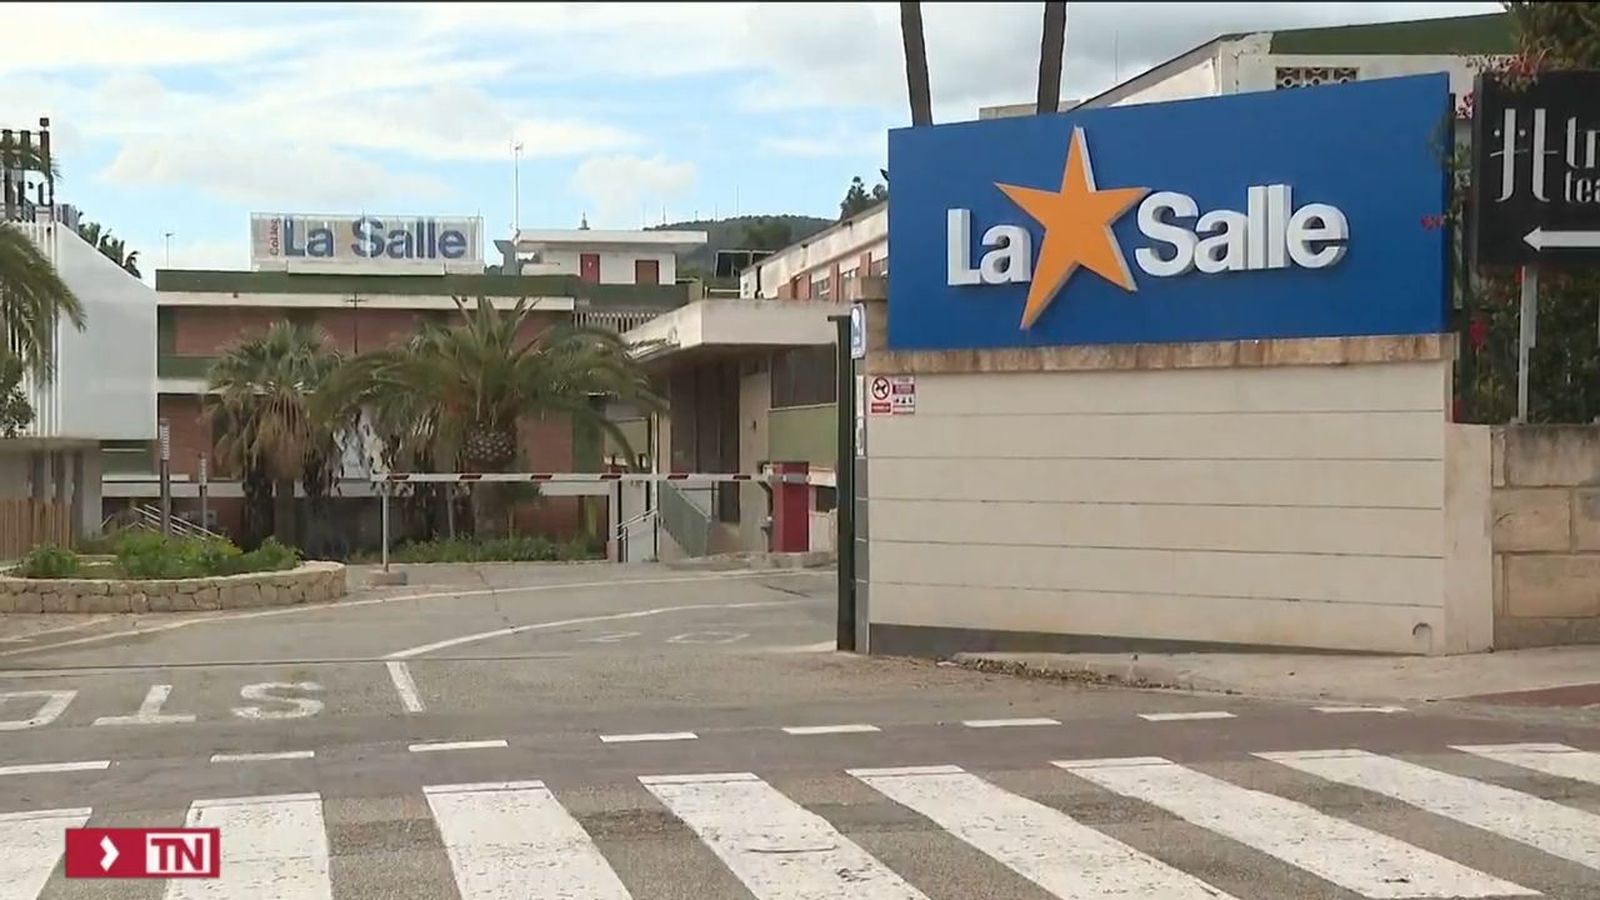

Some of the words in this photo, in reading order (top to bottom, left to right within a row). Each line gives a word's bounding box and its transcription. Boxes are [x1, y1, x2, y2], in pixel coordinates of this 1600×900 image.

[283, 215, 334, 258] La
[351, 216, 467, 259] Salle
[947, 208, 1032, 286] La
[1135, 183, 1349, 277] Salle
